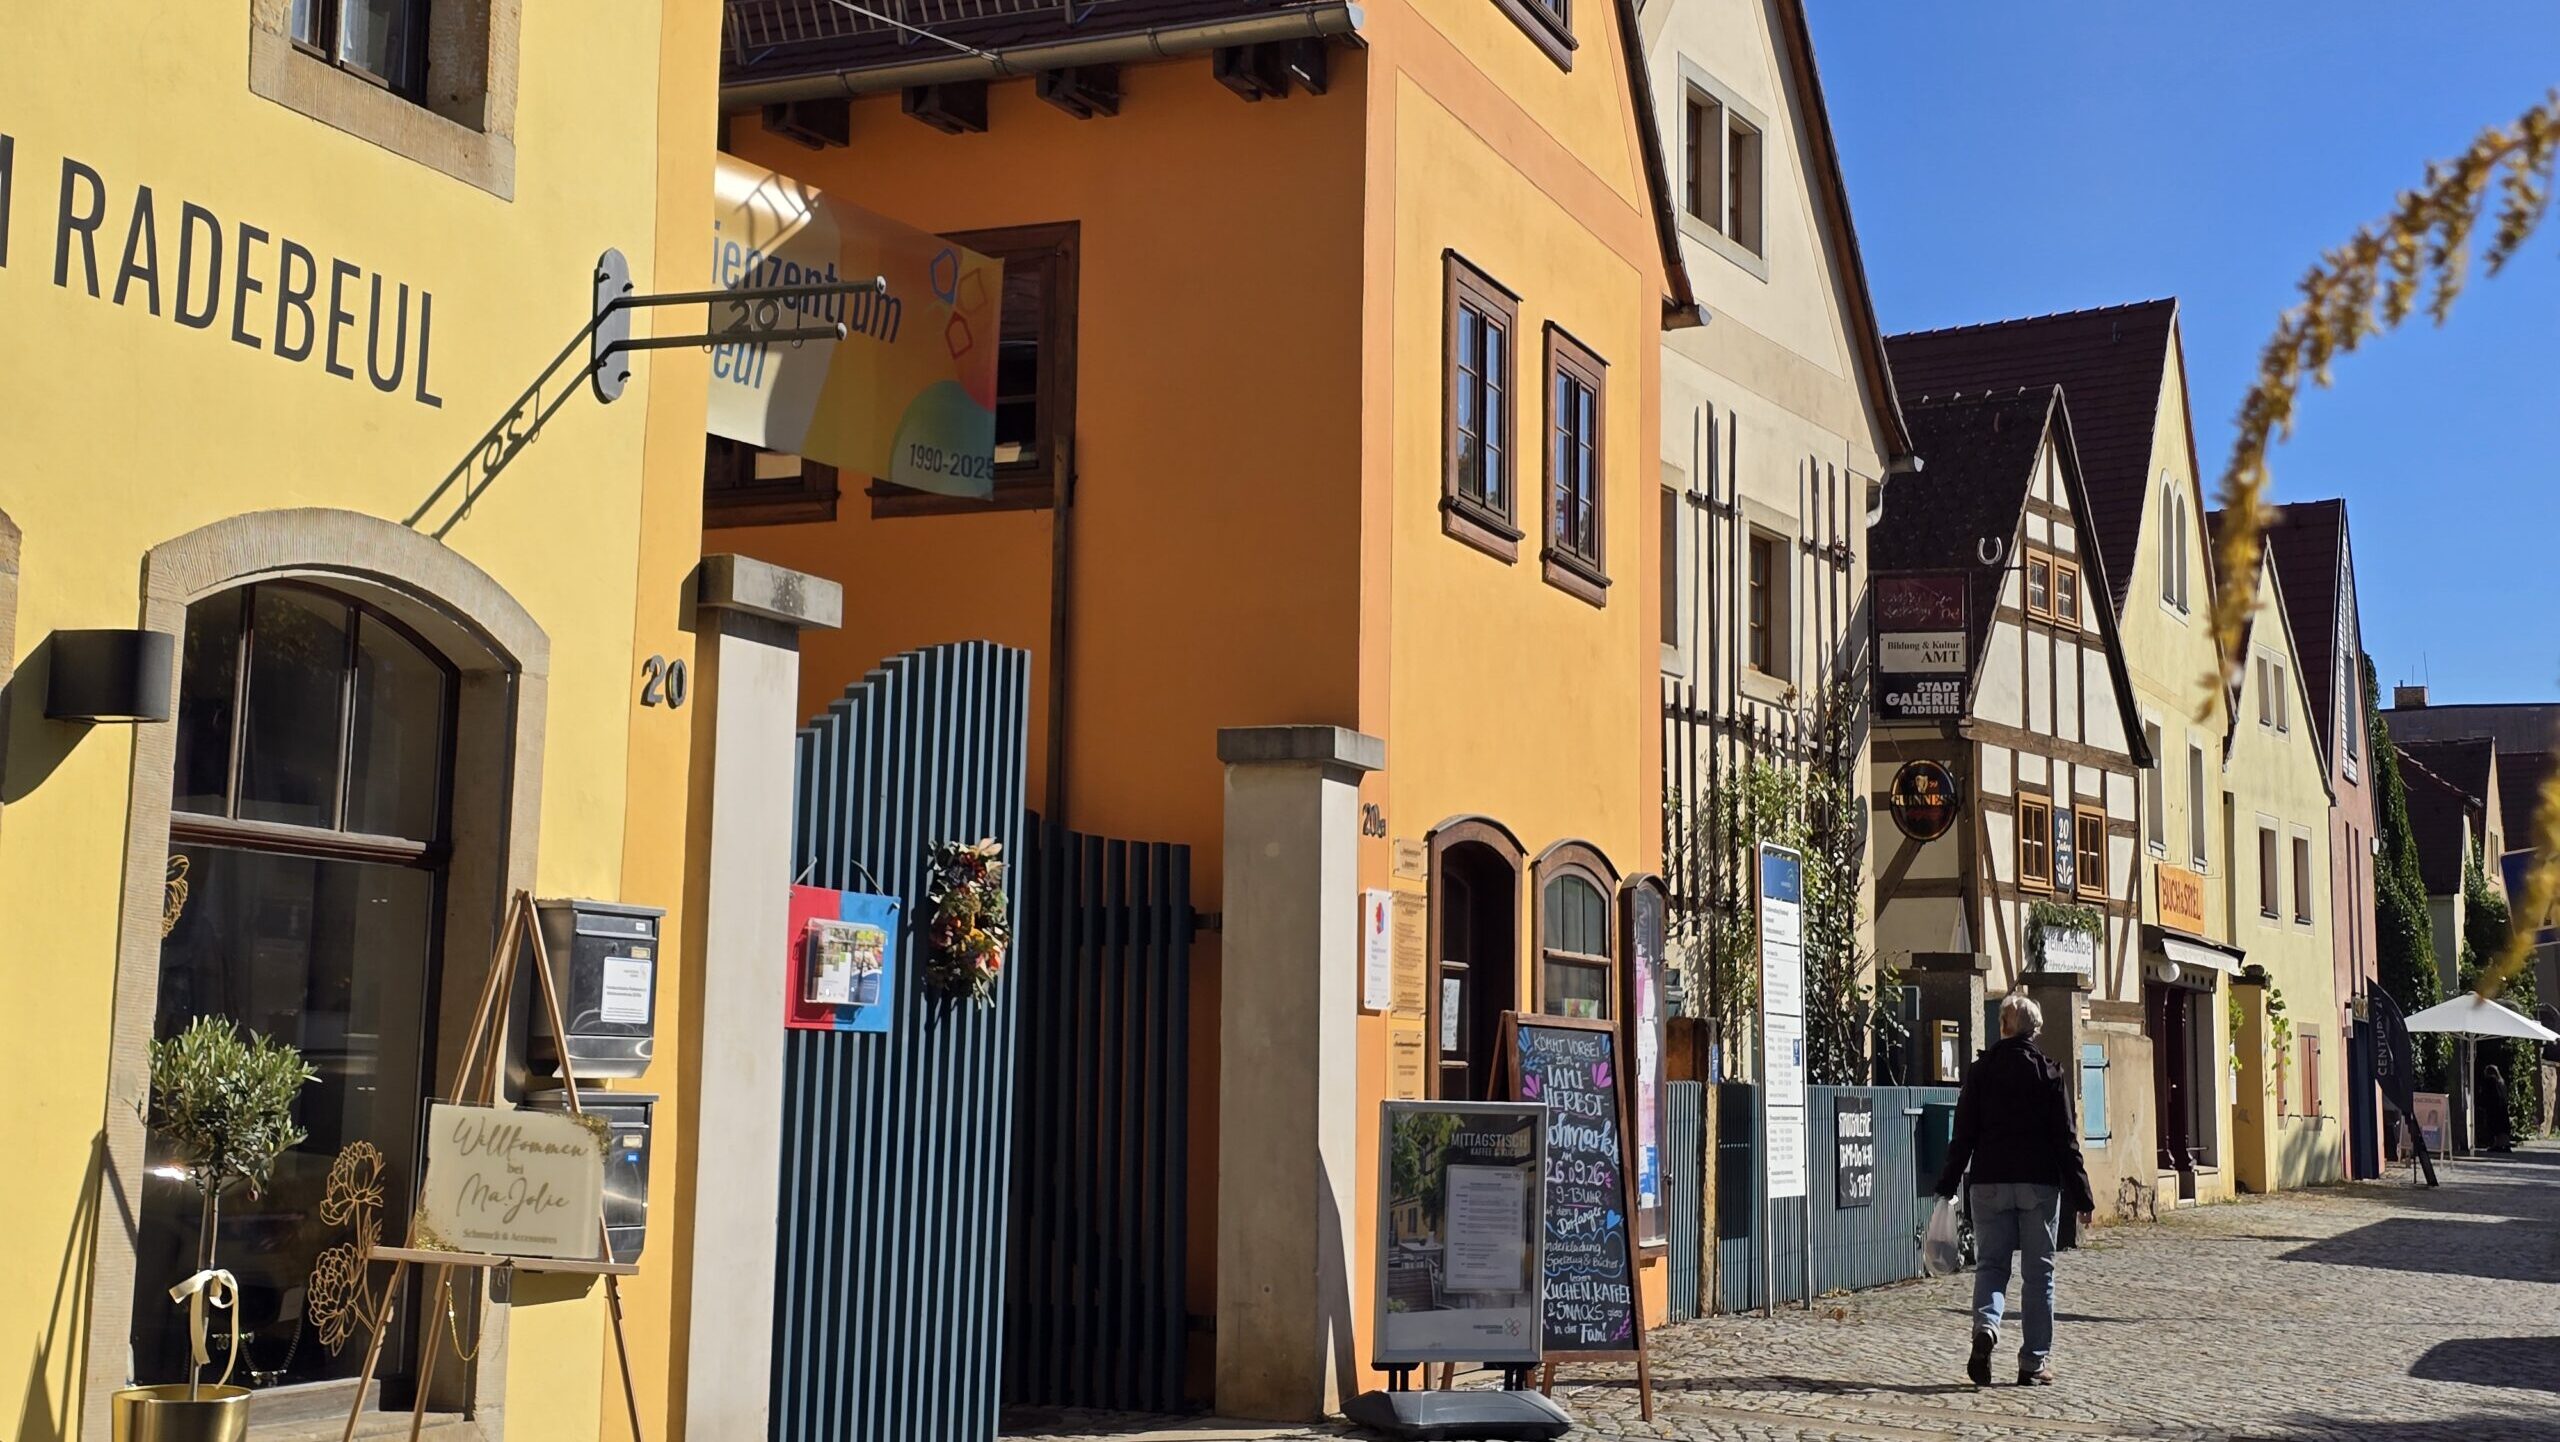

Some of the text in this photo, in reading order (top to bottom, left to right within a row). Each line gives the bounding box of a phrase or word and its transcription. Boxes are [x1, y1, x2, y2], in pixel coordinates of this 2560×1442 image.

[53, 156, 443, 409] RADEBEUL
[910, 443, 994, 480] 1990-2025
[1887, 641, 1960, 651] Bildung & Kultur
[1921, 651, 1959, 663] AMT
[640, 655, 687, 709] 20
[1917, 682, 1960, 692] STADT
[1886, 693, 1960, 706] GALERIE
[1902, 706, 1960, 715] RADEBEUL
[2058, 817, 2070, 840] 20
[2375, 1011, 2388, 1076] CENTURY
[452, 1116, 588, 1161] Willkommen
[1451, 1132, 1529, 1149] MITTAGSTISCH
[506, 1163, 525, 1174] bei
